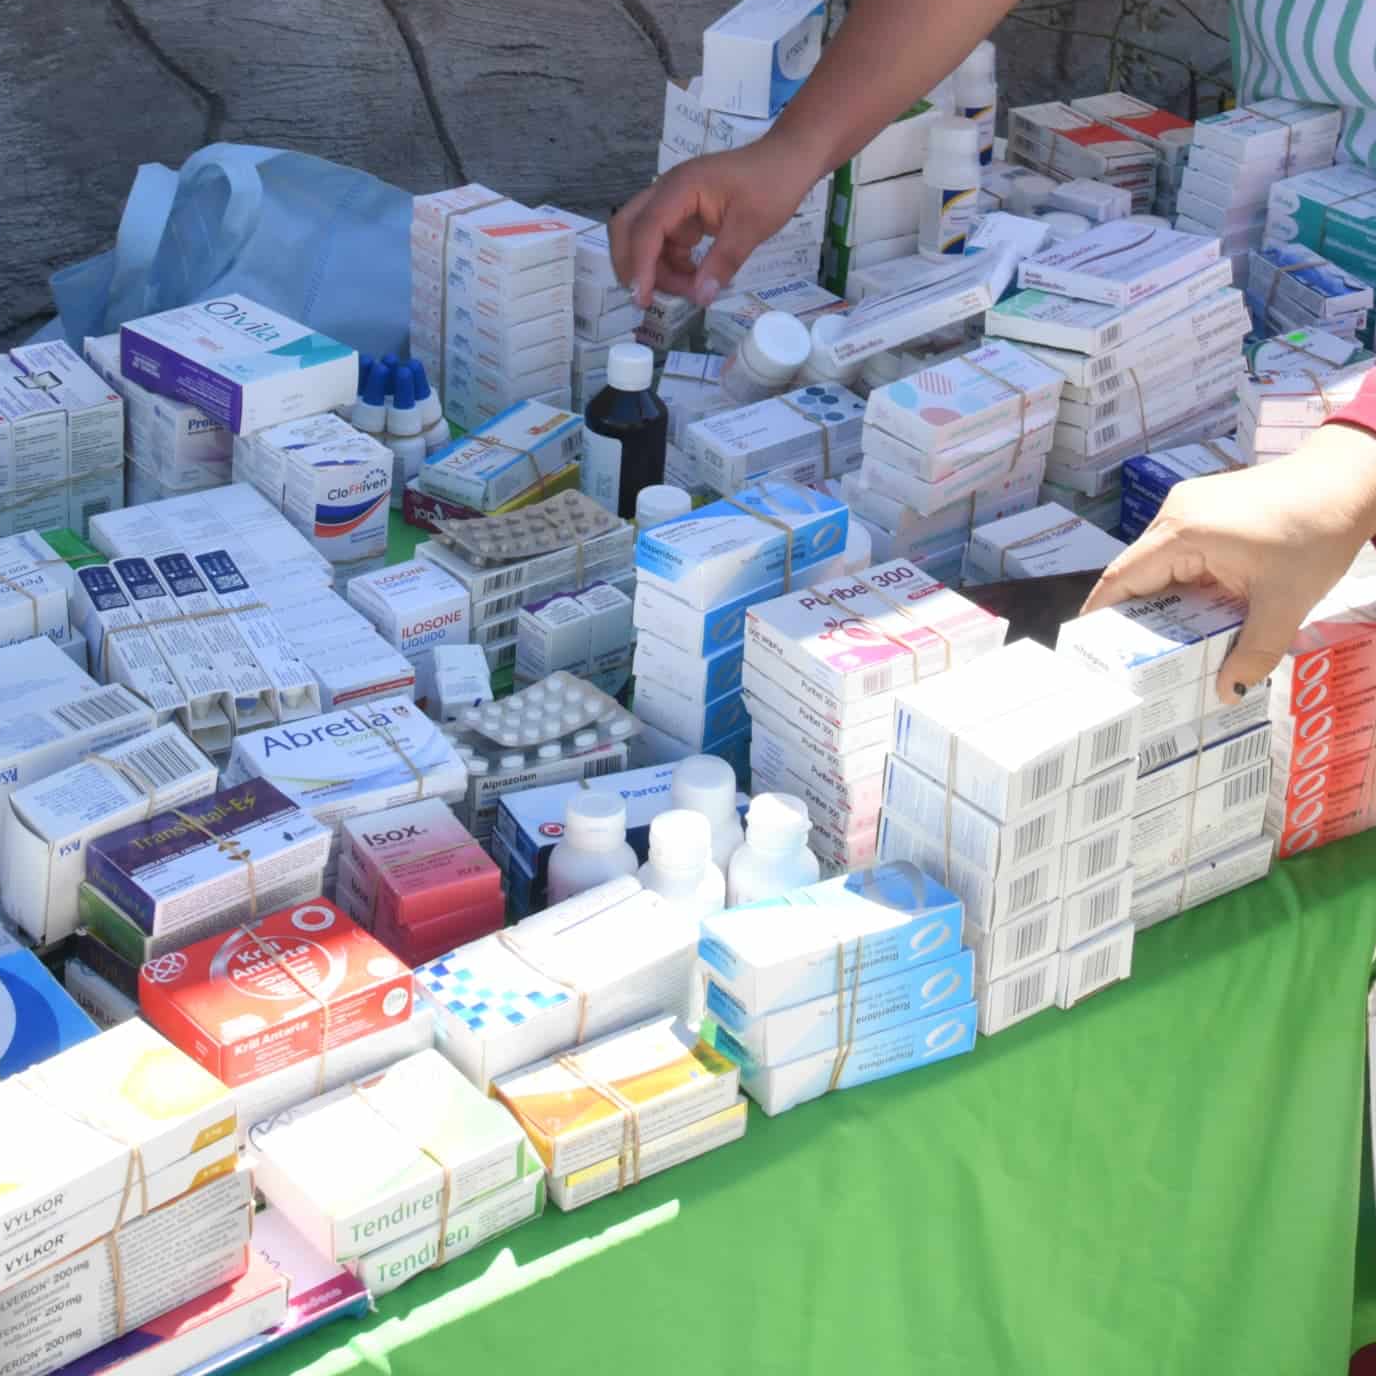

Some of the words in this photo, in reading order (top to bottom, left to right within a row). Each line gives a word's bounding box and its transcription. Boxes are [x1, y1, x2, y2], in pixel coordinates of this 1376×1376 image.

[798, 582, 870, 611] Puribe
[871, 566, 914, 589] 300
[401, 610, 462, 640] ILOSONE
[481, 772, 537, 790] Alprazolam
[2, 1193, 64, 1232] VYLKOR
[5, 1234, 65, 1273] VYLKOR
